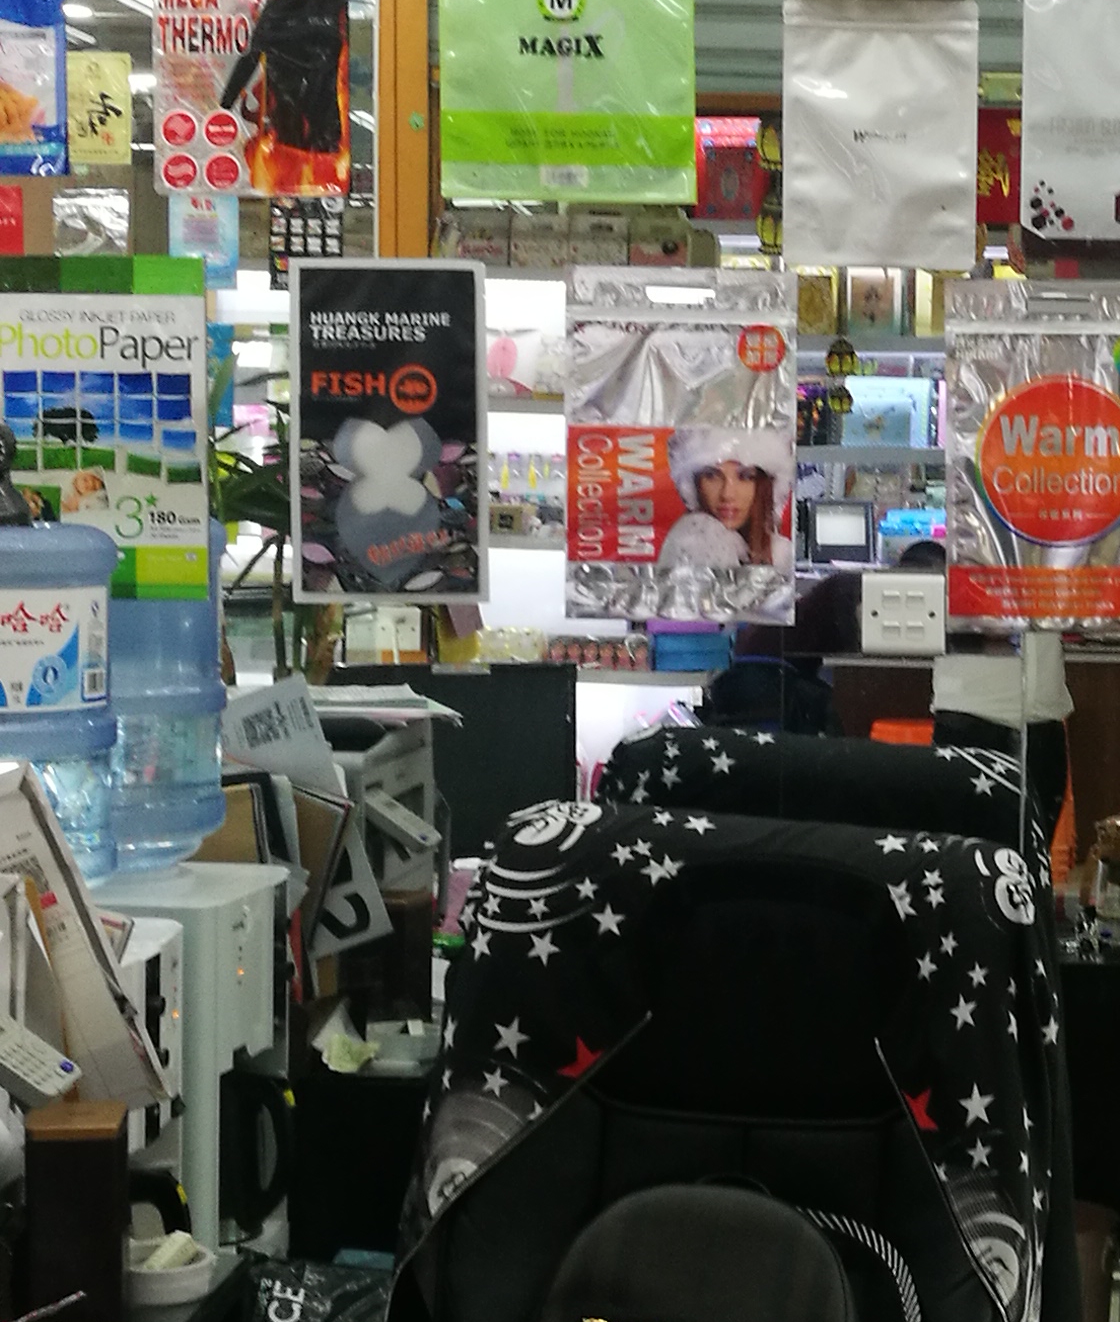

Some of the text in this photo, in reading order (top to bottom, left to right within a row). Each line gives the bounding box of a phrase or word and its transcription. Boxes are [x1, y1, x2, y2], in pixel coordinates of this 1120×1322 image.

[157, 14, 250, 54] THERMO
[19, 308, 177, 325] GLOSSY INKJET PAPER
[384, 312, 451, 327] MARINE
[310, 324, 427, 343] TREASURES
[310, 370, 387, 396] FISH
[999, 413, 1120, 458] Warm
[576, 433, 614, 556] Collection
[616, 433, 656, 557] WARM
[149, 510, 177, 525] 180
